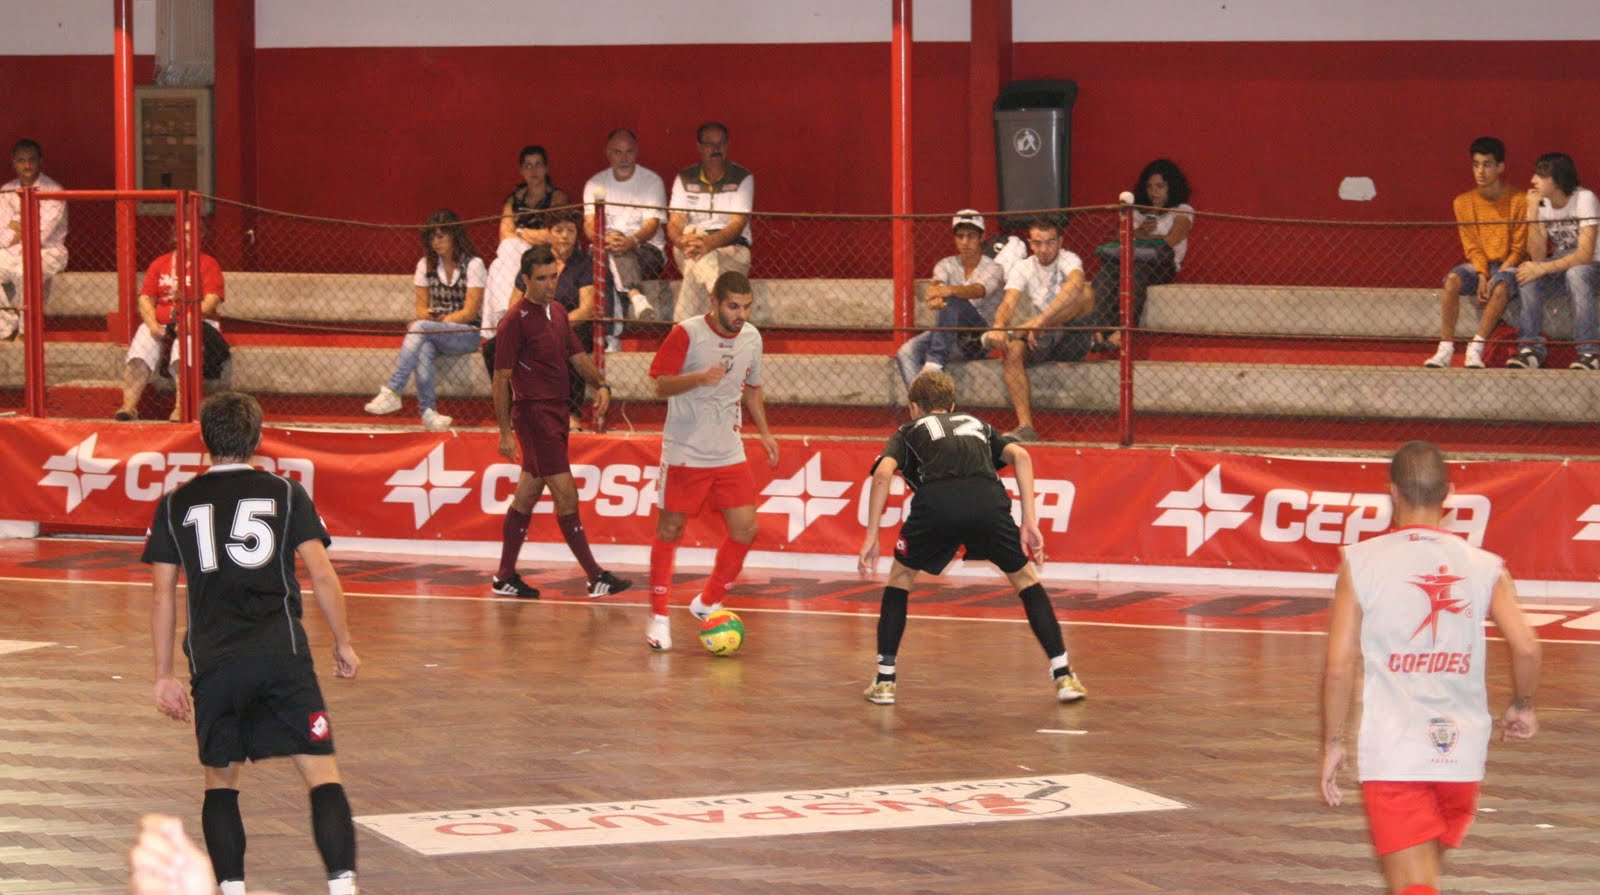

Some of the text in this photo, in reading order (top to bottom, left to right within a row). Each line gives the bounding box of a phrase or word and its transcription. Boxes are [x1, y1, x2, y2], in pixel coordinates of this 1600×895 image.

[915, 415, 988, 443] 12
[125, 452, 314, 503] CEA
[481, 463, 661, 517] CPS
[183, 498, 277, 572] 15
[1260, 488, 1491, 548] CEPA
[1388, 652, 1472, 675] COFIDES
[685, 798, 753, 808] DE
